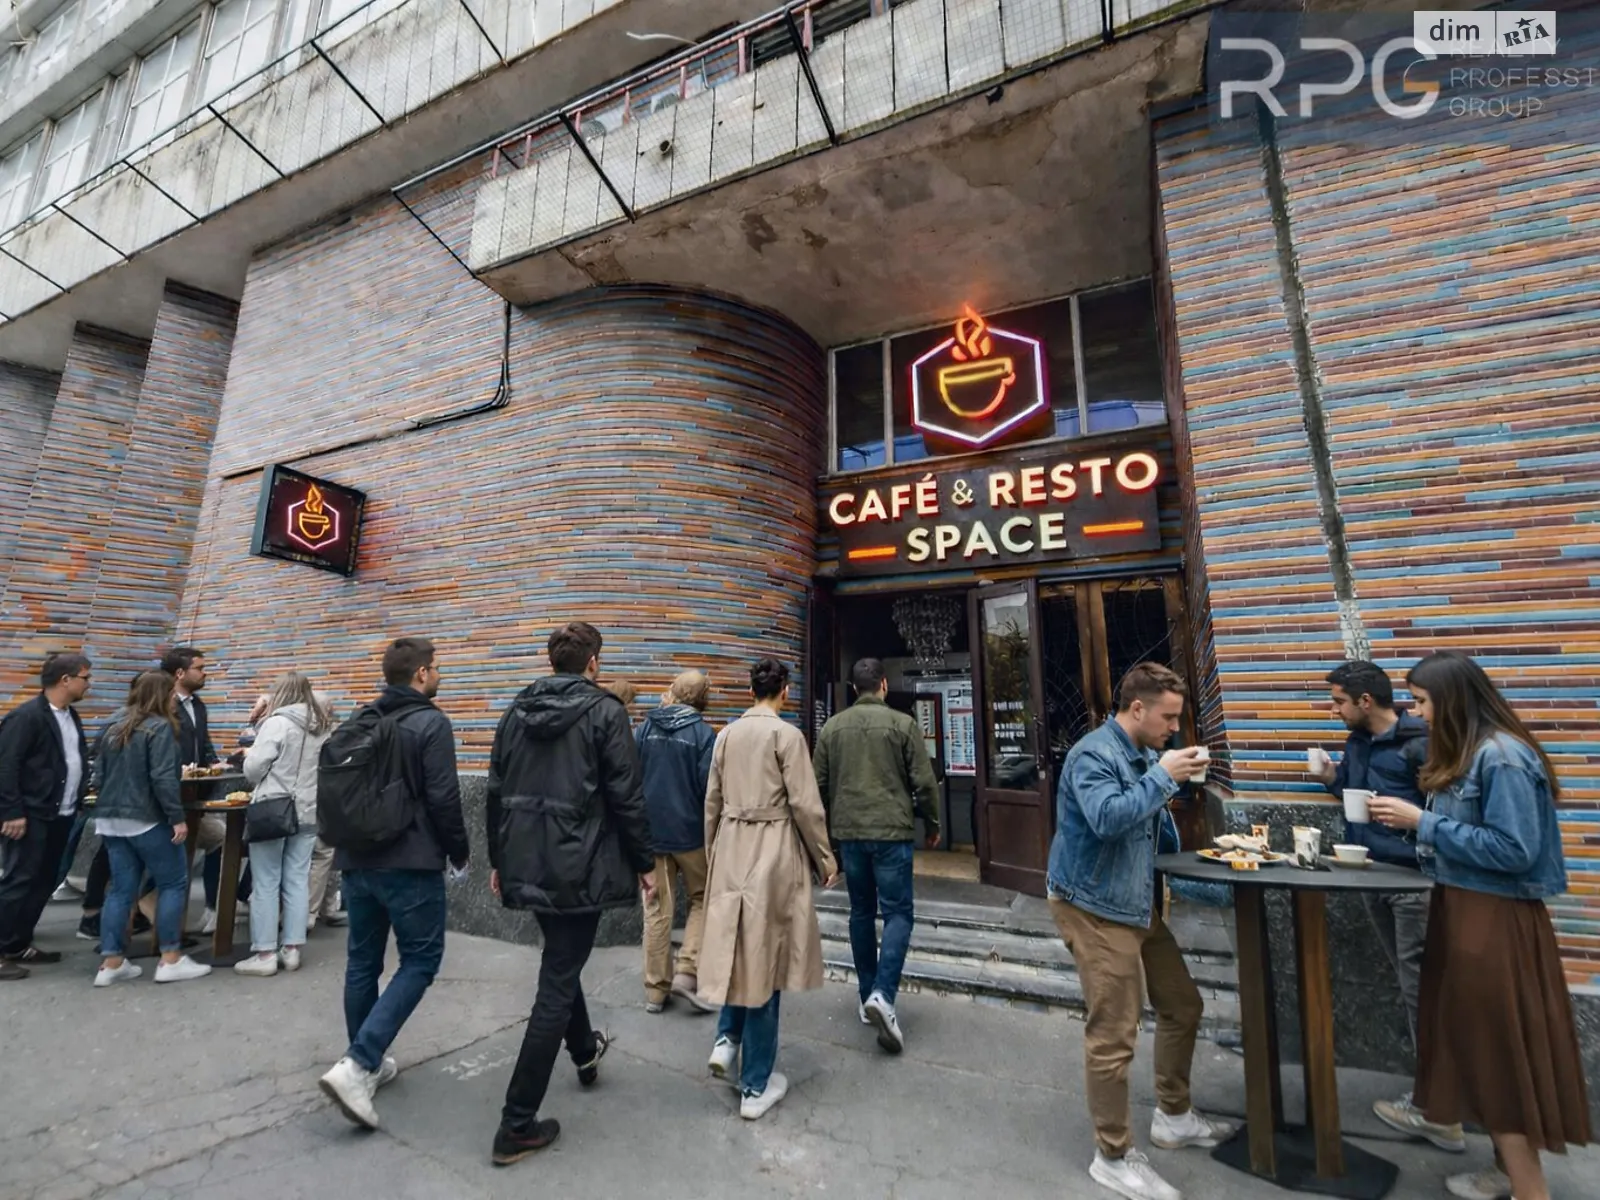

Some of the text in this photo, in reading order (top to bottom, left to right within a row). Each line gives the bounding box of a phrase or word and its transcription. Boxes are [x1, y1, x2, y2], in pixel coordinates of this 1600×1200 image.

[829, 452, 1159, 525] CAFÉ & RESTO
[907, 512, 1067, 562] SPACE
